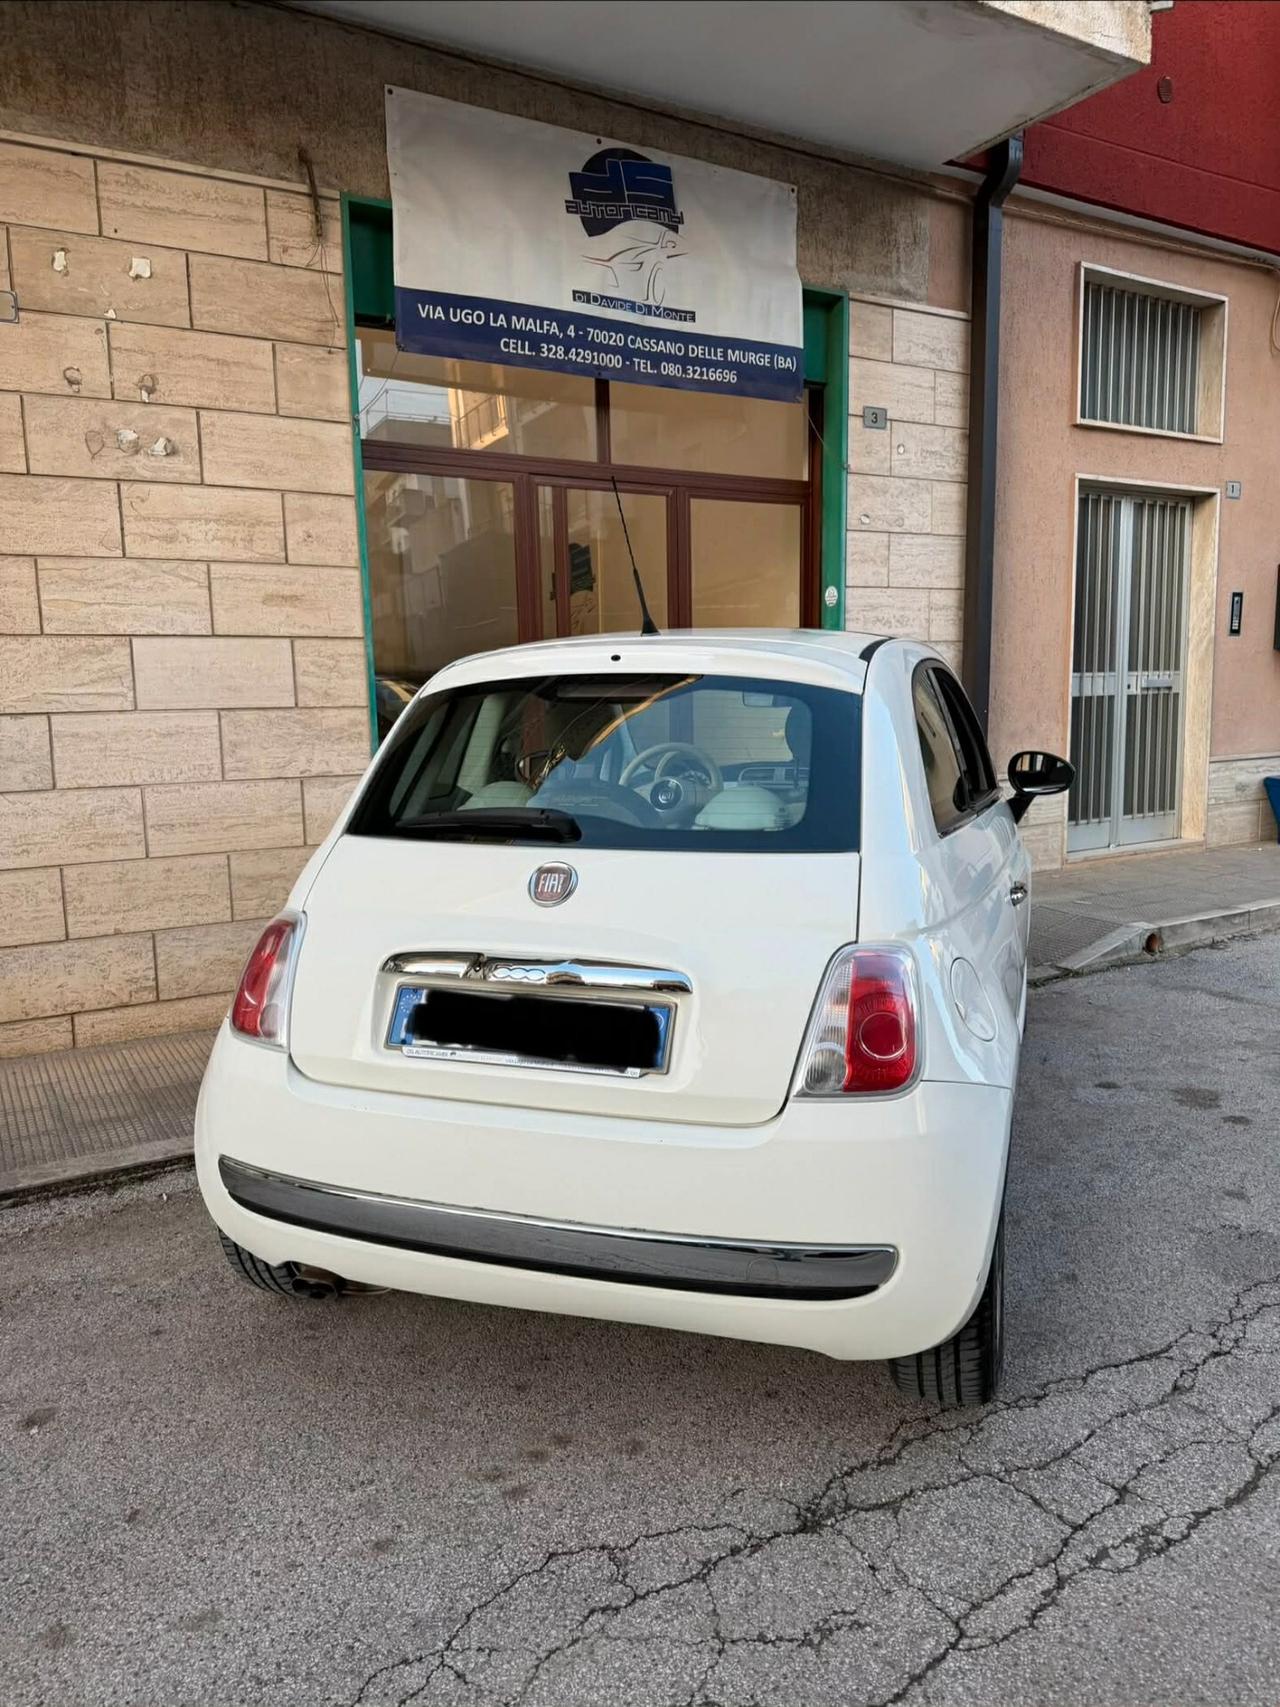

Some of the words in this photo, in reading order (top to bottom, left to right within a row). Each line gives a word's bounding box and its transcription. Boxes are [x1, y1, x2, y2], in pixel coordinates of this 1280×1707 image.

[417, 303, 445, 321] VIA
[449, 308, 485, 325] UGO
[490, 312, 507, 329] LA
[511, 315, 564, 339] MALFA,
[567, 324, 575, 338] 4
[586, 327, 624, 346] 70020
[627, 335, 685, 356] CASSANO
[689, 344, 724, 361] DELLE
[727, 349, 771, 367] MURGE
[774, 354, 797, 373] (BA)
[500, 337, 536, 356] CELL.
[539, 343, 623, 369] 328.4291000
[632, 357, 657, 374] TEL.
[660, 362, 738, 384] 080.3216696
[871, 411, 878, 424] 3
[537, 873, 567, 893] FIAT
